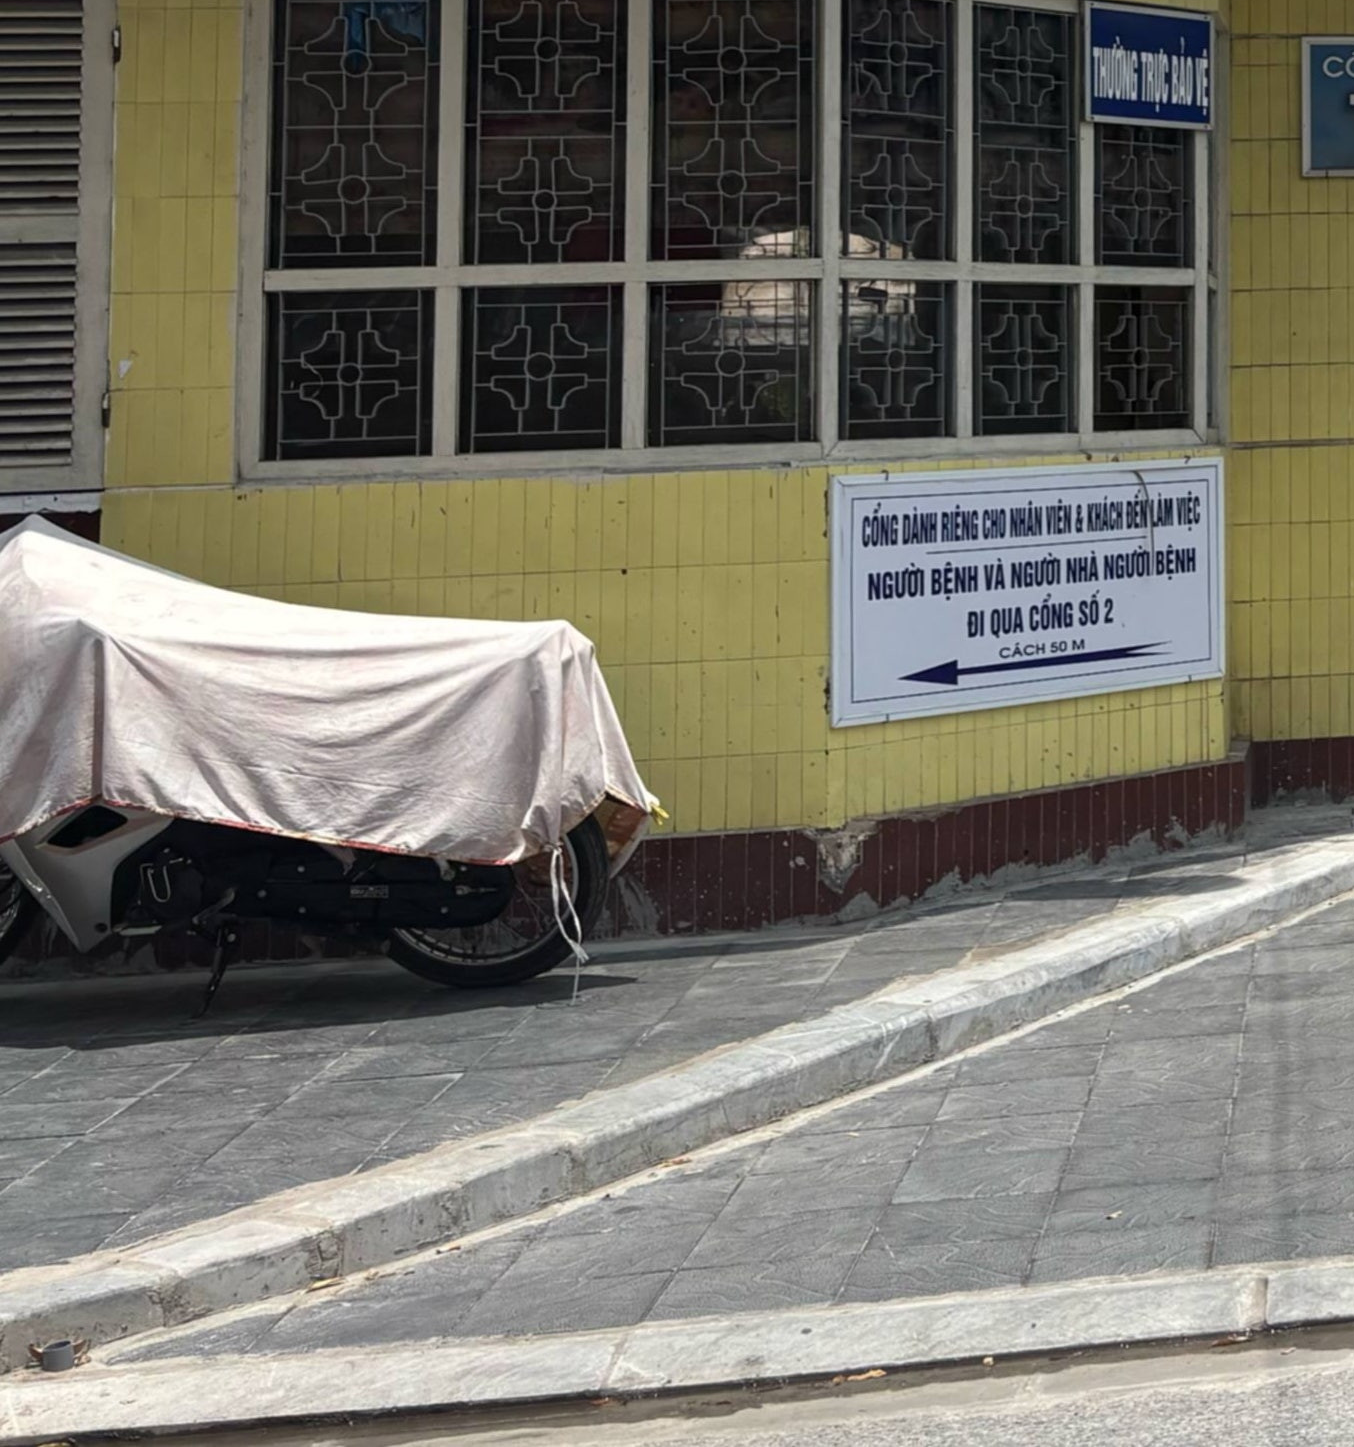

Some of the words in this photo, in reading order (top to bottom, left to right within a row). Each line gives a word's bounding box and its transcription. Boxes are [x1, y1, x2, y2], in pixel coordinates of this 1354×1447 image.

[1093, 36, 1138, 102] THƯỜNG
[1140, 47, 1169, 113] TRỰC
[1172, 36, 1193, 106] BẢO
[1195, 49, 1209, 116] VỆ
[862, 502, 898, 547] CỔNG
[903, 506, 937, 545] DÀNH
[941, 505, 978, 542] RIÊNG
[983, 508, 1006, 539] CHO
[1010, 500, 1042, 537] NHÂN
[1046, 499, 1072, 535] VIÊN
[1075, 504, 1083, 532] &
[1087, 496, 1123, 532] KHÁCH
[1126, 489, 1148, 529] ĐẾN
[1151, 493, 1173, 527] LÀM
[1177, 491, 1200, 531] VIỆC
[868, 563, 924, 600] NGƯỜI
[931, 562, 978, 601] BỆNH
[984, 558, 1005, 591] VÀ
[1011, 552, 1060, 588] NGƯỜI
[1066, 551, 1098, 583] NHÀ
[1104, 545, 1150, 580] NGƯỜI
[1156, 544, 1196, 580] BỆNH
[968, 610, 984, 638] ĐI
[991, 607, 1023, 638] QUA
[1030, 593, 1073, 631] CỔNG
[1079, 590, 1100, 626] SỐ
[1104, 598, 1114, 623] 2
[999, 643, 1045, 659] CÁCH
[1050, 641, 1068, 653] 50
[1072, 639, 1085, 650] M
